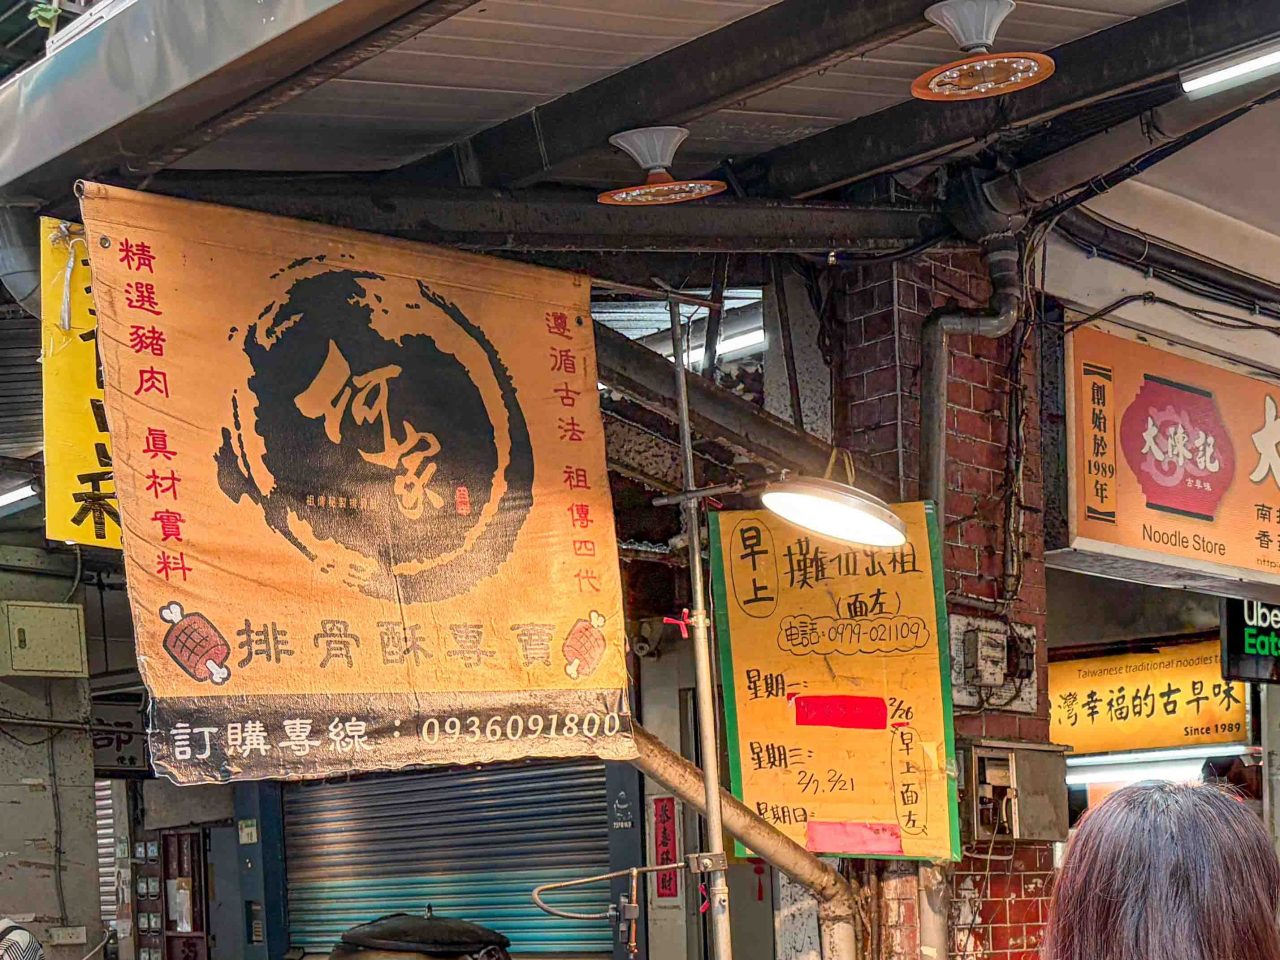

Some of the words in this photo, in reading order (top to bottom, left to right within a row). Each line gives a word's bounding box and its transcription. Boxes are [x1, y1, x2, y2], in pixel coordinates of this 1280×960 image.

[118, 237, 171, 399] 精選豬肉
[545, 311, 586, 442] 遵循古法
[293, 338, 445, 520] 何家
[1086, 381, 1115, 504] 創始於1989年
[1141, 416, 1221, 473] 大陳記
[563, 464, 601, 593] 祖傳四代
[1142, 522, 1190, 550] Noodle
[1192, 533, 1227, 556] Store
[739, 525, 775, 606] 早上
[236, 616, 557, 669] 排骨酥專賣
[1077, 664, 1123, 679] Taiwanese
[1124, 659, 1175, 673] traditional
[1175, 655, 1213, 668] noodles
[888, 697, 914, 720] 2/26
[1049, 680, 1242, 728] 灣幸福的古早味
[1183, 726, 1211, 737] Since
[1214, 722, 1241, 734] 1989
